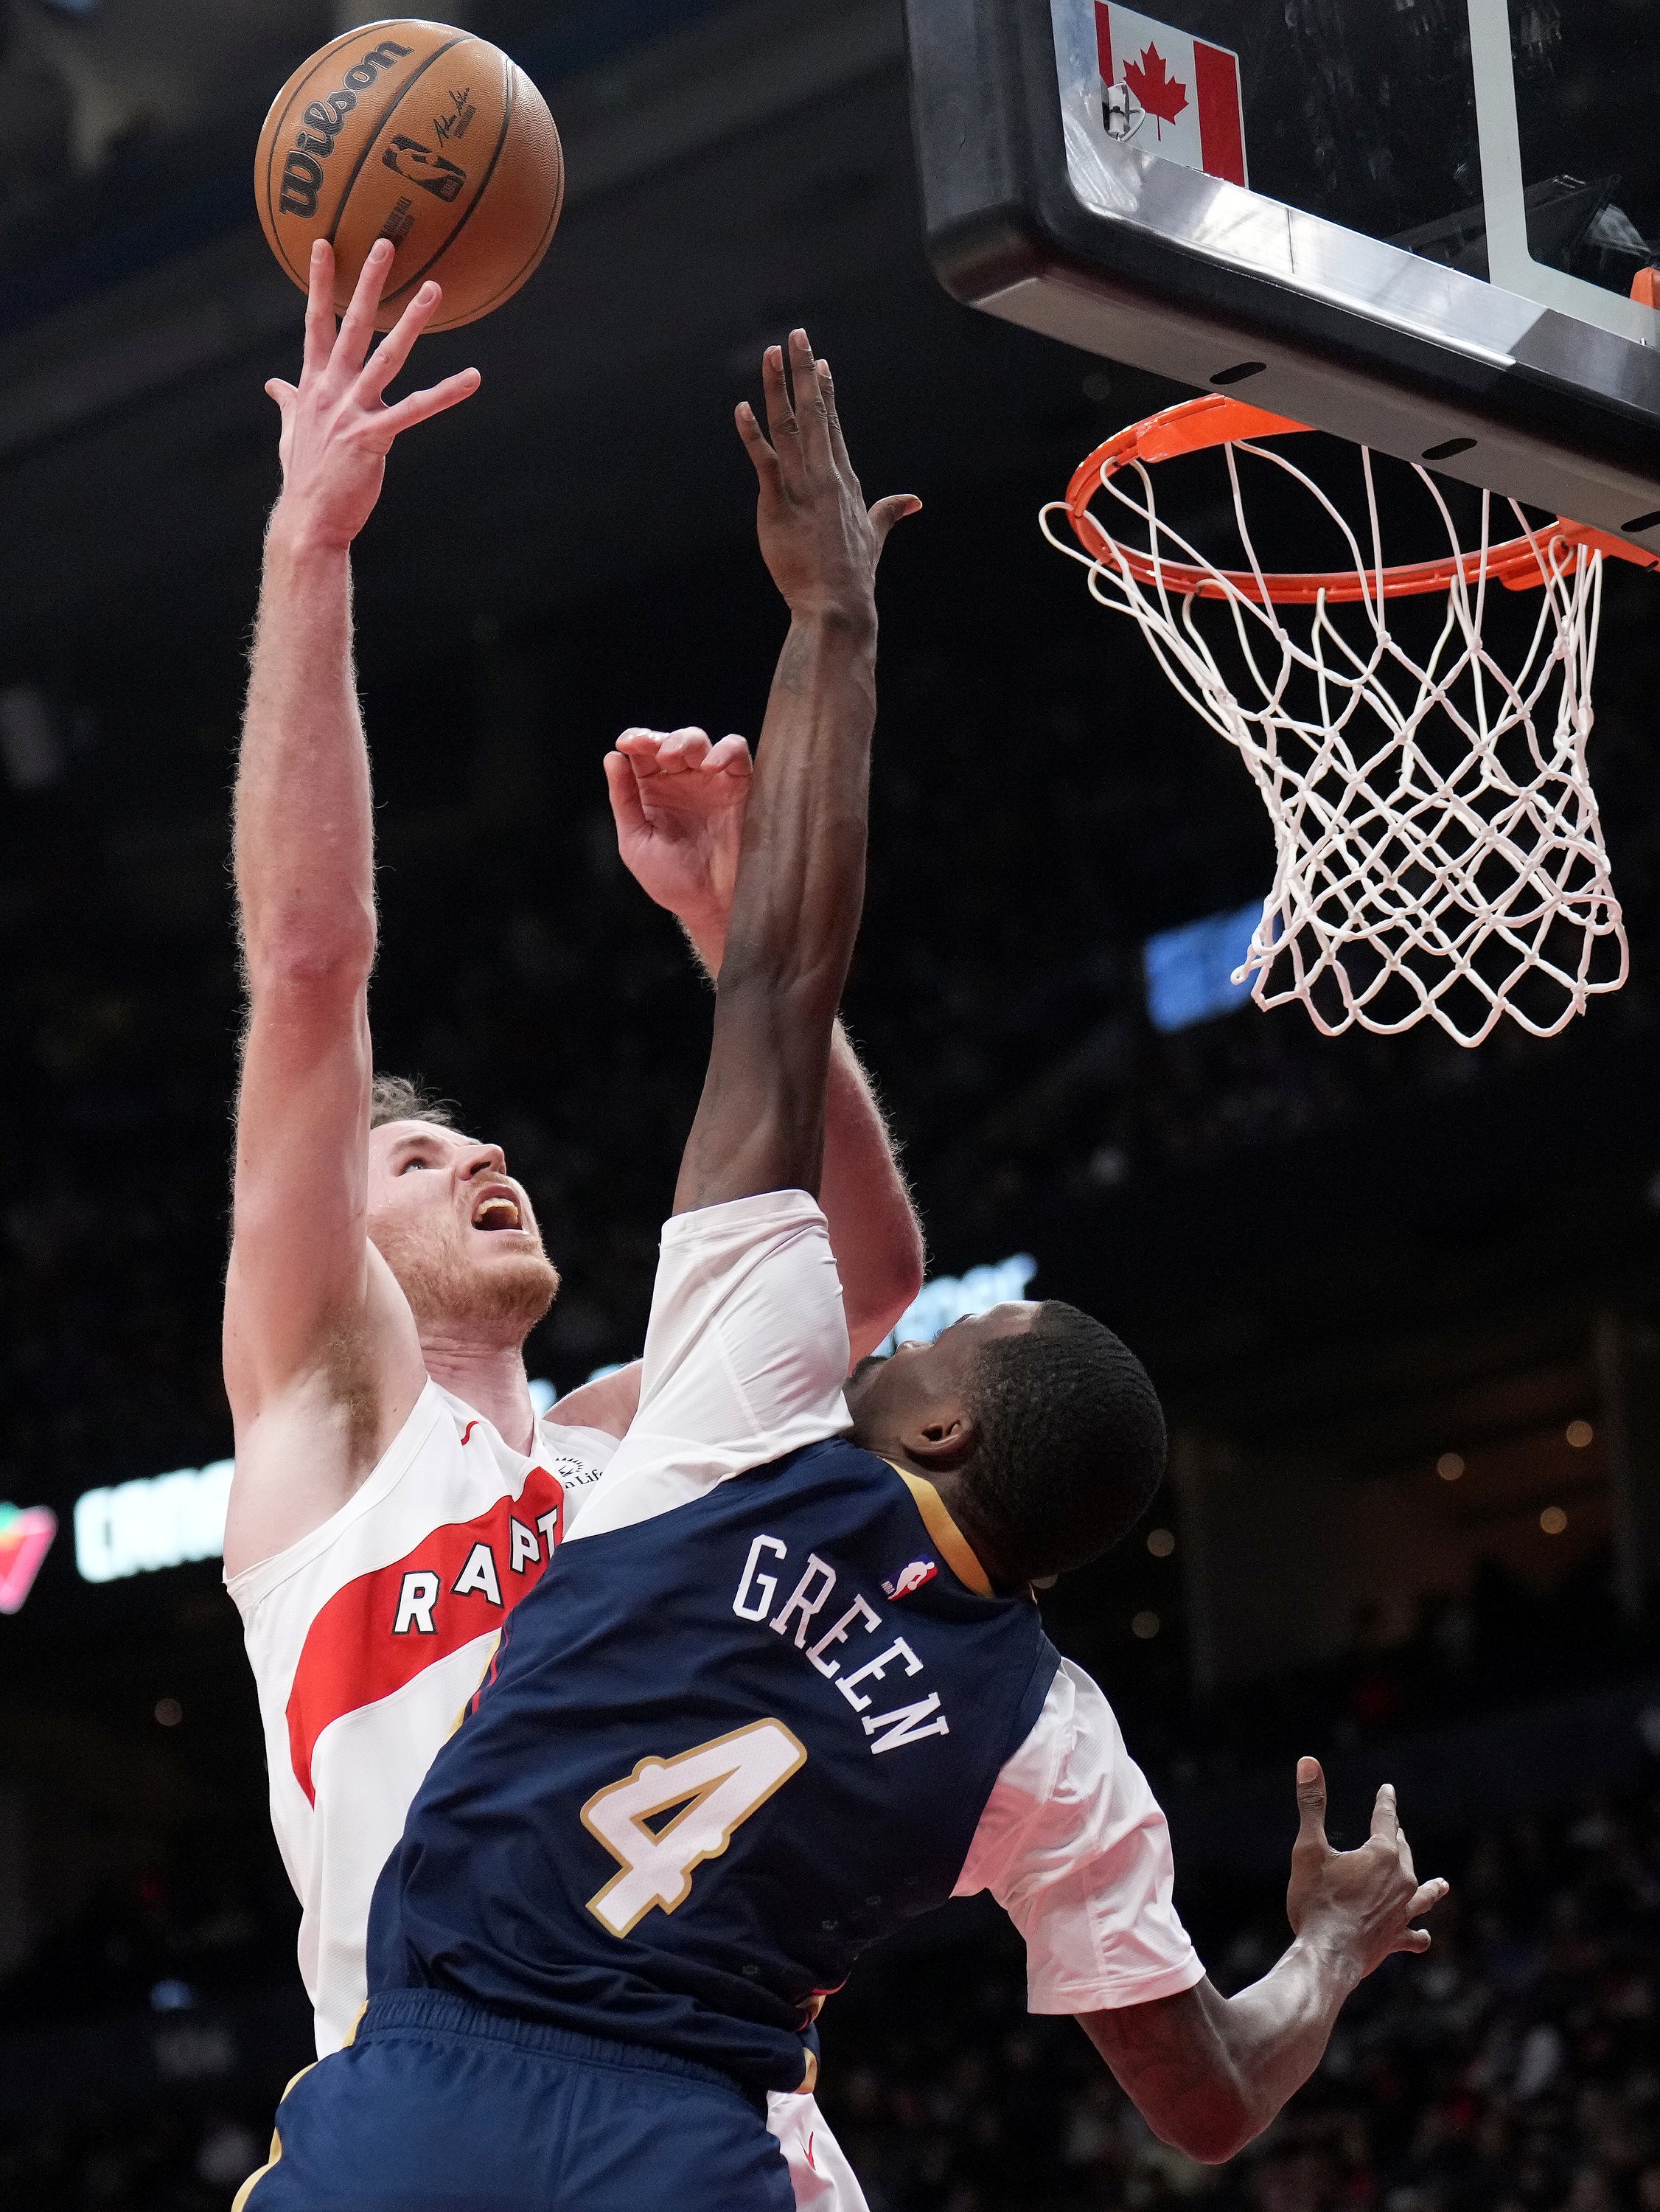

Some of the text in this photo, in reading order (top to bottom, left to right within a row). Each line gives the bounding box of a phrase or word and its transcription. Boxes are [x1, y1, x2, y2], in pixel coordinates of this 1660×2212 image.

[279, 41, 414, 219] Wilson
[732, 1534, 949, 1755] GREEN
[881, 1580, 895, 1595] NBA
[579, 1717, 808, 1939] 4
